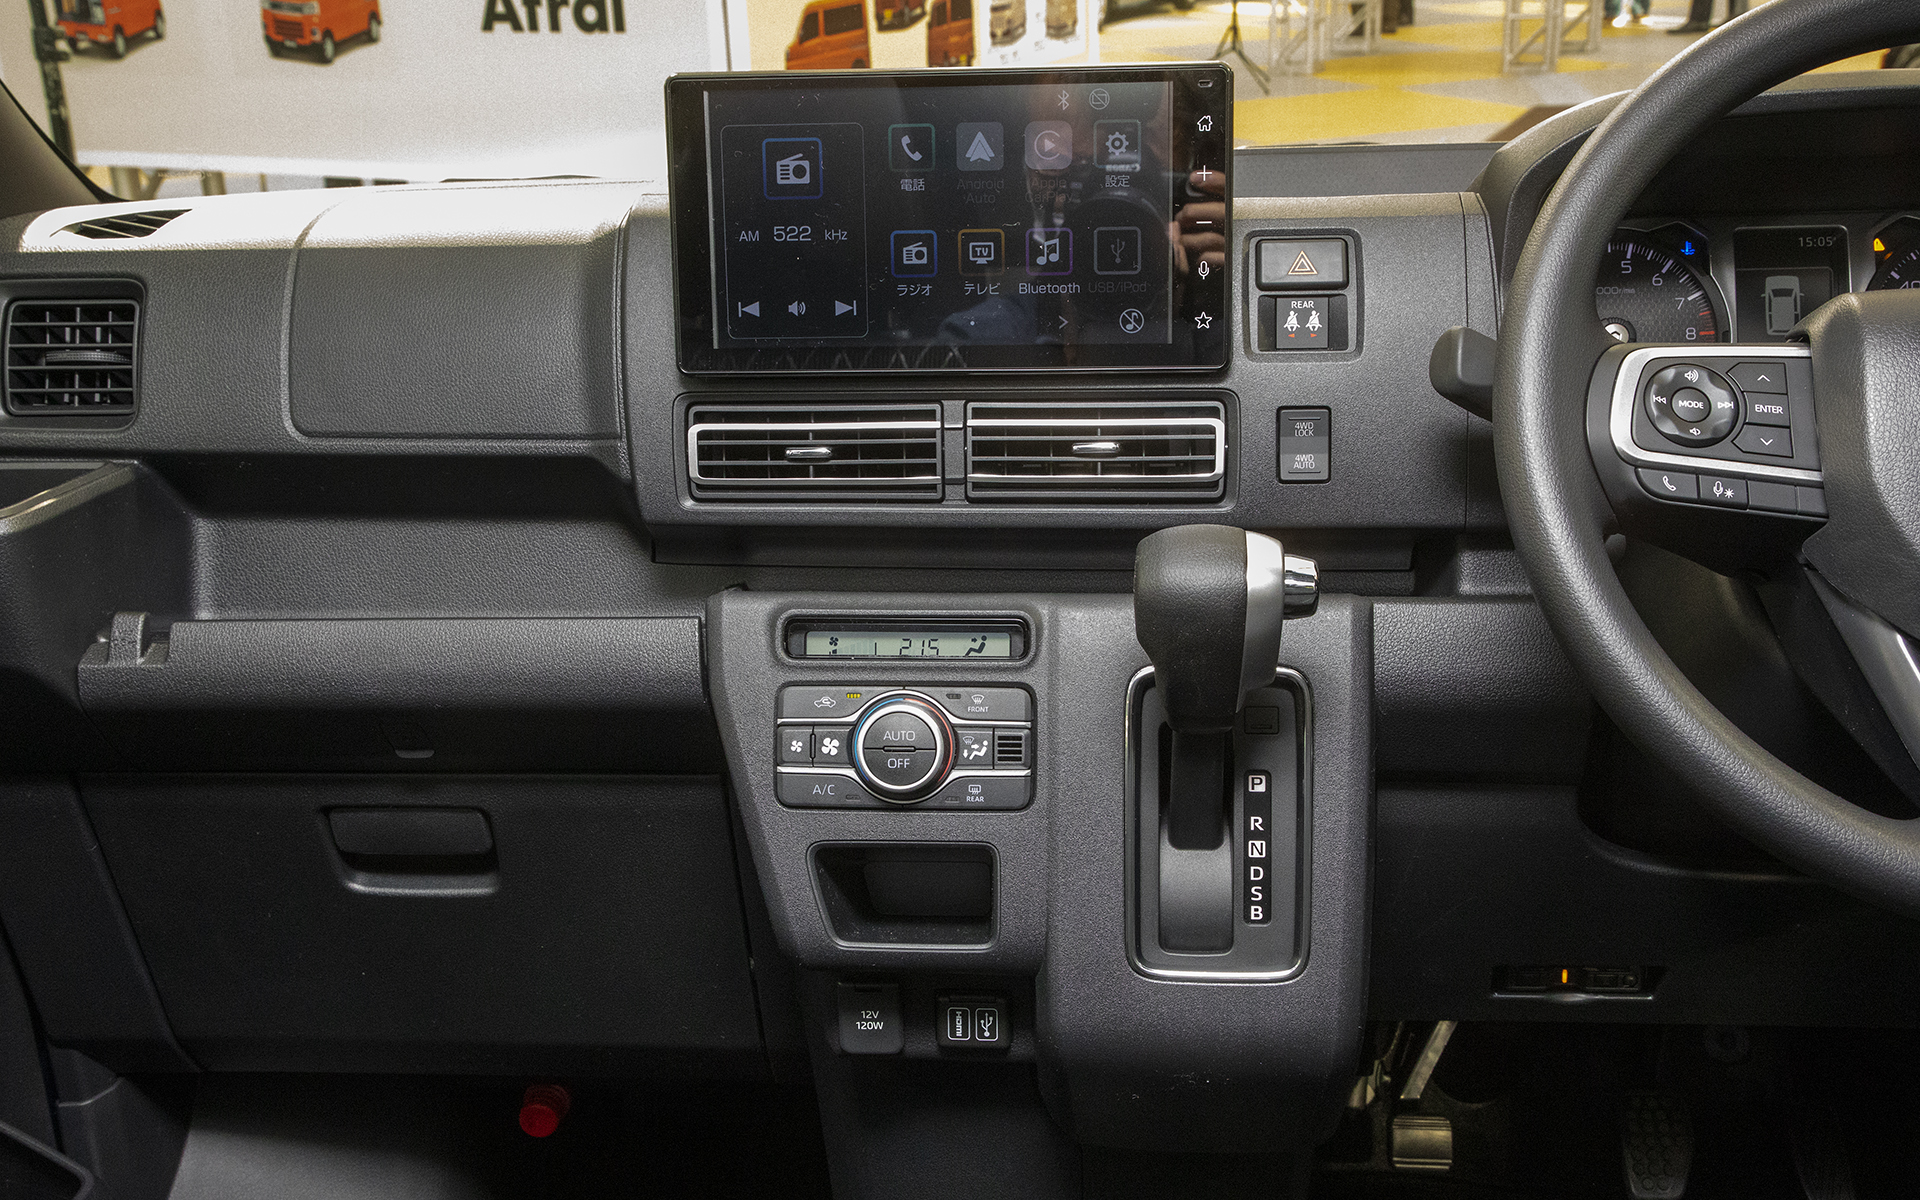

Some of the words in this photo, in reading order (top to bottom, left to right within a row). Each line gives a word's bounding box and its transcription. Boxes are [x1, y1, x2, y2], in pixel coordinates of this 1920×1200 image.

[900, 178, 925, 192] 電話
[957, 179, 1004, 191] Android
[1032, 179, 1067, 191] Apple
[1105, 174, 1130, 188] 設定
[966, 193, 996, 204] Auto
[739, 230, 760, 242] AM
[773, 225, 812, 242] 522
[824, 229, 848, 241] kHz
[1799, 236, 1833, 247] 15:05
[976, 247, 989, 256] TV
[1621, 260, 1632, 274] 5
[1652, 273, 1663, 286] 6
[897, 285, 932, 296] ラジオ
[964, 282, 1000, 295] テレビ
[1018, 282, 1081, 295] Bluetooth
[1291, 301, 1314, 309] REAR
[1674, 297, 1686, 310] 7
[1685, 327, 1697, 340] 8
[1678, 399, 1704, 409] MODE
[1754, 402, 1784, 415] ENTER
[1294, 422, 1314, 430] 4WD
[1294, 428, 1314, 437] LOCK
[1293, 460, 1315, 469] AUTO
[1294, 454, 1314, 463] 4WD
[883, 730, 916, 742] AUTO
[887, 758, 910, 769] OFF
[812, 784, 835, 796] A/C
[1251, 777, 1263, 791] P
[966, 795, 985, 803] REAR
[1250, 816, 1264, 831] R
[1250, 842, 1263, 856] N
[1250, 866, 1264, 881] D
[1250, 886, 1263, 901] S
[1250, 905, 1263, 920] B
[861, 1010, 879, 1019] 12V
[856, 1021, 884, 1030] 120W
[955, 1011, 963, 1037] HDMI
